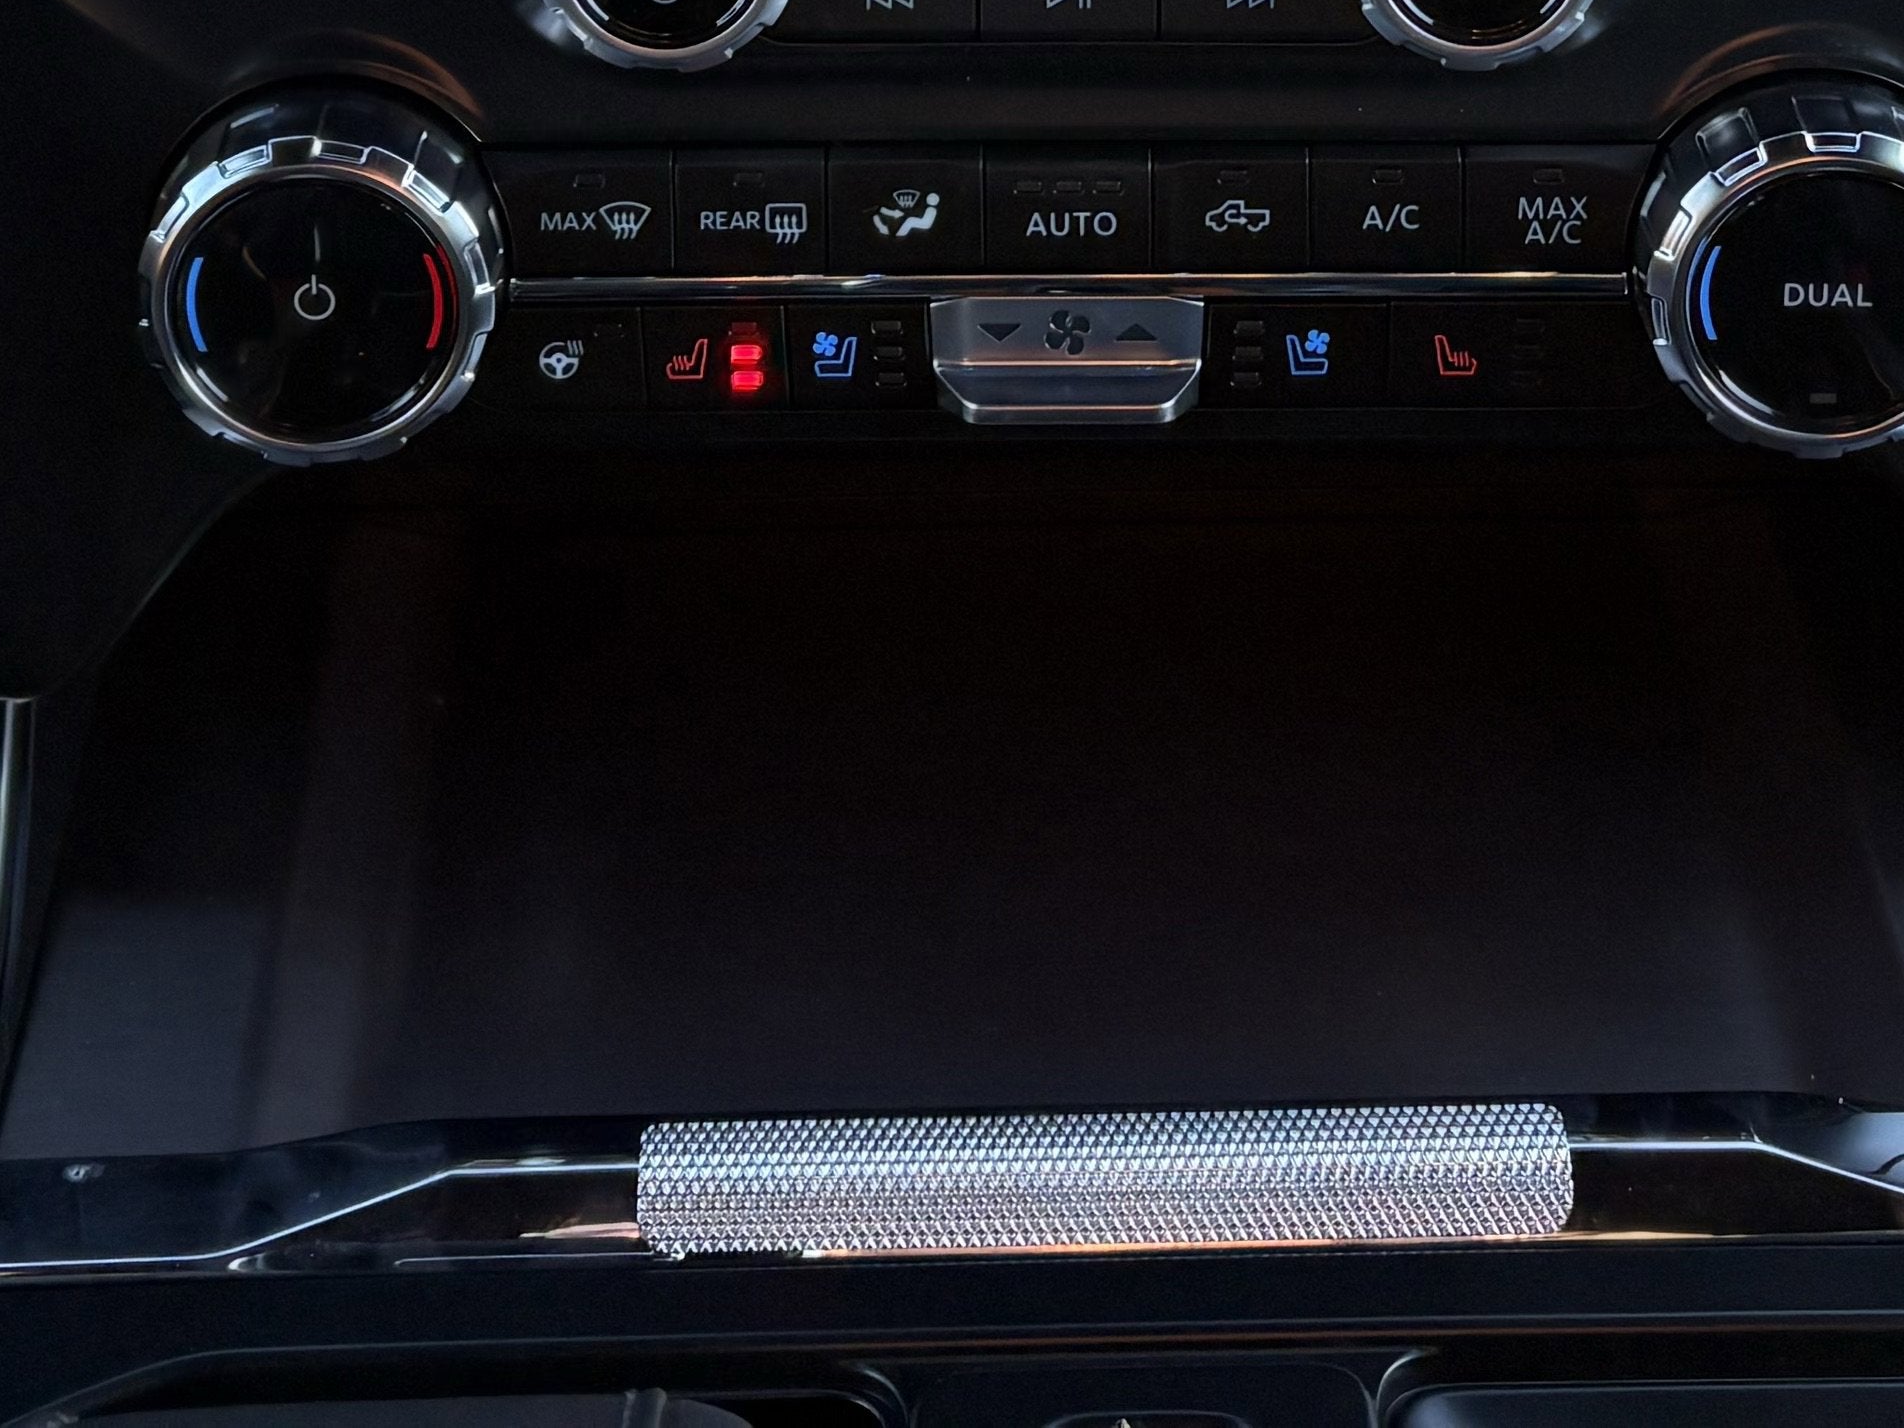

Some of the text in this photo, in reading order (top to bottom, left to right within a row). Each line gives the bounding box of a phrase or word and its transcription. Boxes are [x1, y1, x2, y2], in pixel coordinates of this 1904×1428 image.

[1362, 204, 1419, 232] A/C
[1518, 197, 1587, 219] MAX
[540, 211, 596, 232] MAX
[700, 210, 760, 232] REAR
[1026, 211, 1117, 237] AUTO
[1524, 219, 1583, 247] A/C
[1784, 283, 1873, 307] DUAL
